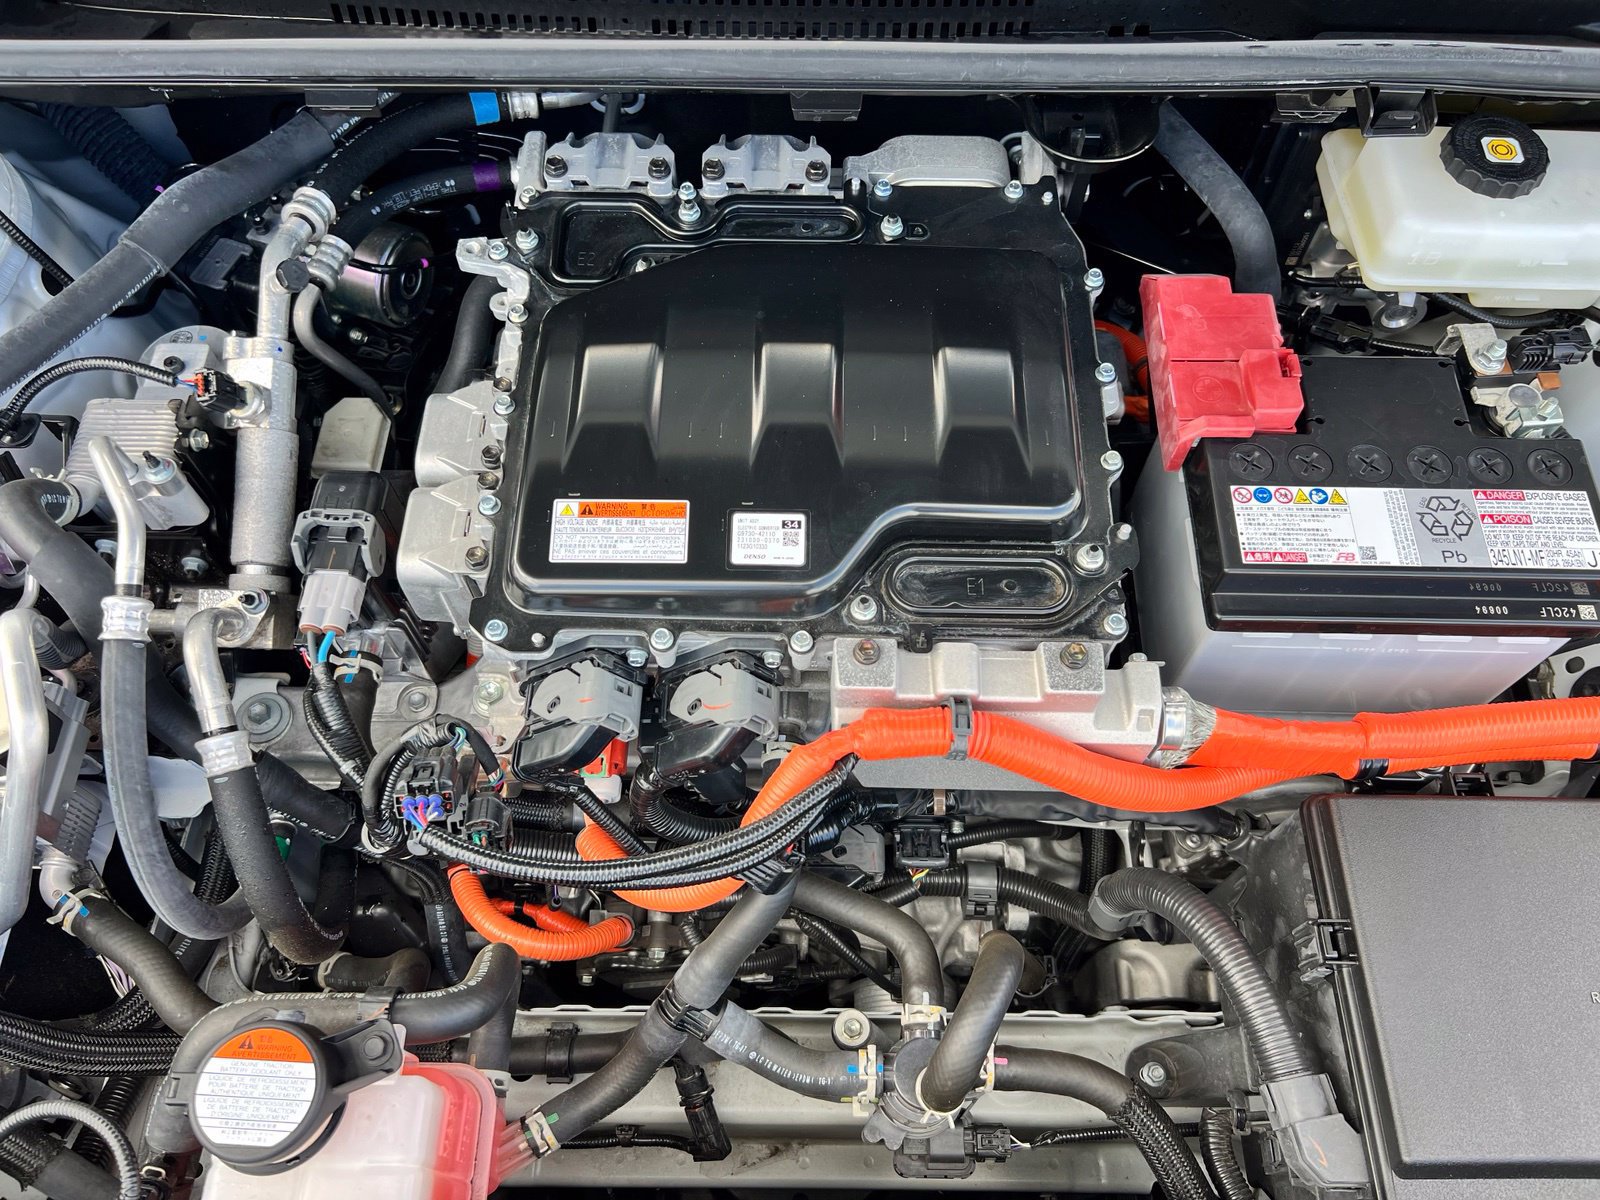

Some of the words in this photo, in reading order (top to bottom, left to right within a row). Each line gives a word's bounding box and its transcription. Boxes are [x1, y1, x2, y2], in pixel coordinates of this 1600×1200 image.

[1486, 492, 1524, 500] DANGER
[1526, 492, 1561, 500] EXPLOSIVE
[1562, 493, 1586, 501] GASES
[784, 520, 799, 528] 34
[1493, 514, 1530, 524] POISON
[1533, 516, 1554, 524] CAUSES
[1554, 516, 1576, 524] SEVERE
[1577, 518, 1594, 526] BURNS
[1282, 552, 1306, 562] DANGER
[1442, 550, 1468, 563] Pb
[1490, 549, 1544, 566] 345LN1-MF
[966, 578, 984, 596] E1
[772, 1064, 792, 1078] WATER
